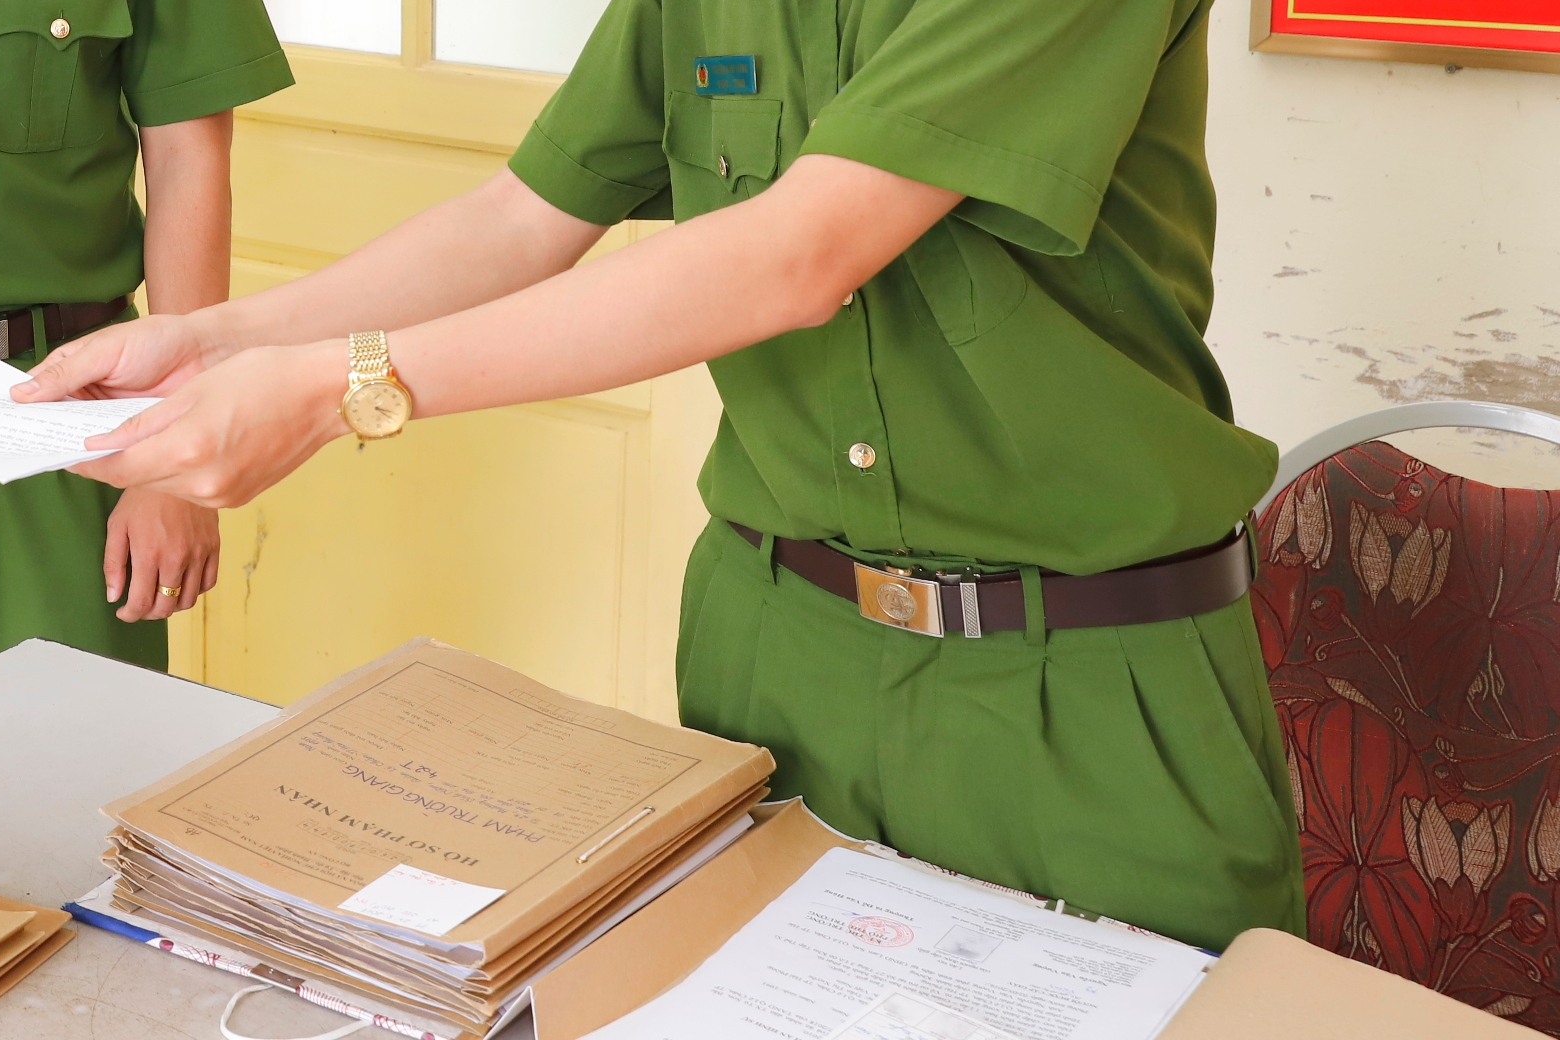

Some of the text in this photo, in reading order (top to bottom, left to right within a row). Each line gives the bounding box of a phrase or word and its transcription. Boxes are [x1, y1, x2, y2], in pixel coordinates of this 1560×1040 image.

[271, 783, 480, 868] HỒ SƠ PHẠM NHÂN
[338, 763, 547, 843] PHẠM TRƯỜNG GIANG
